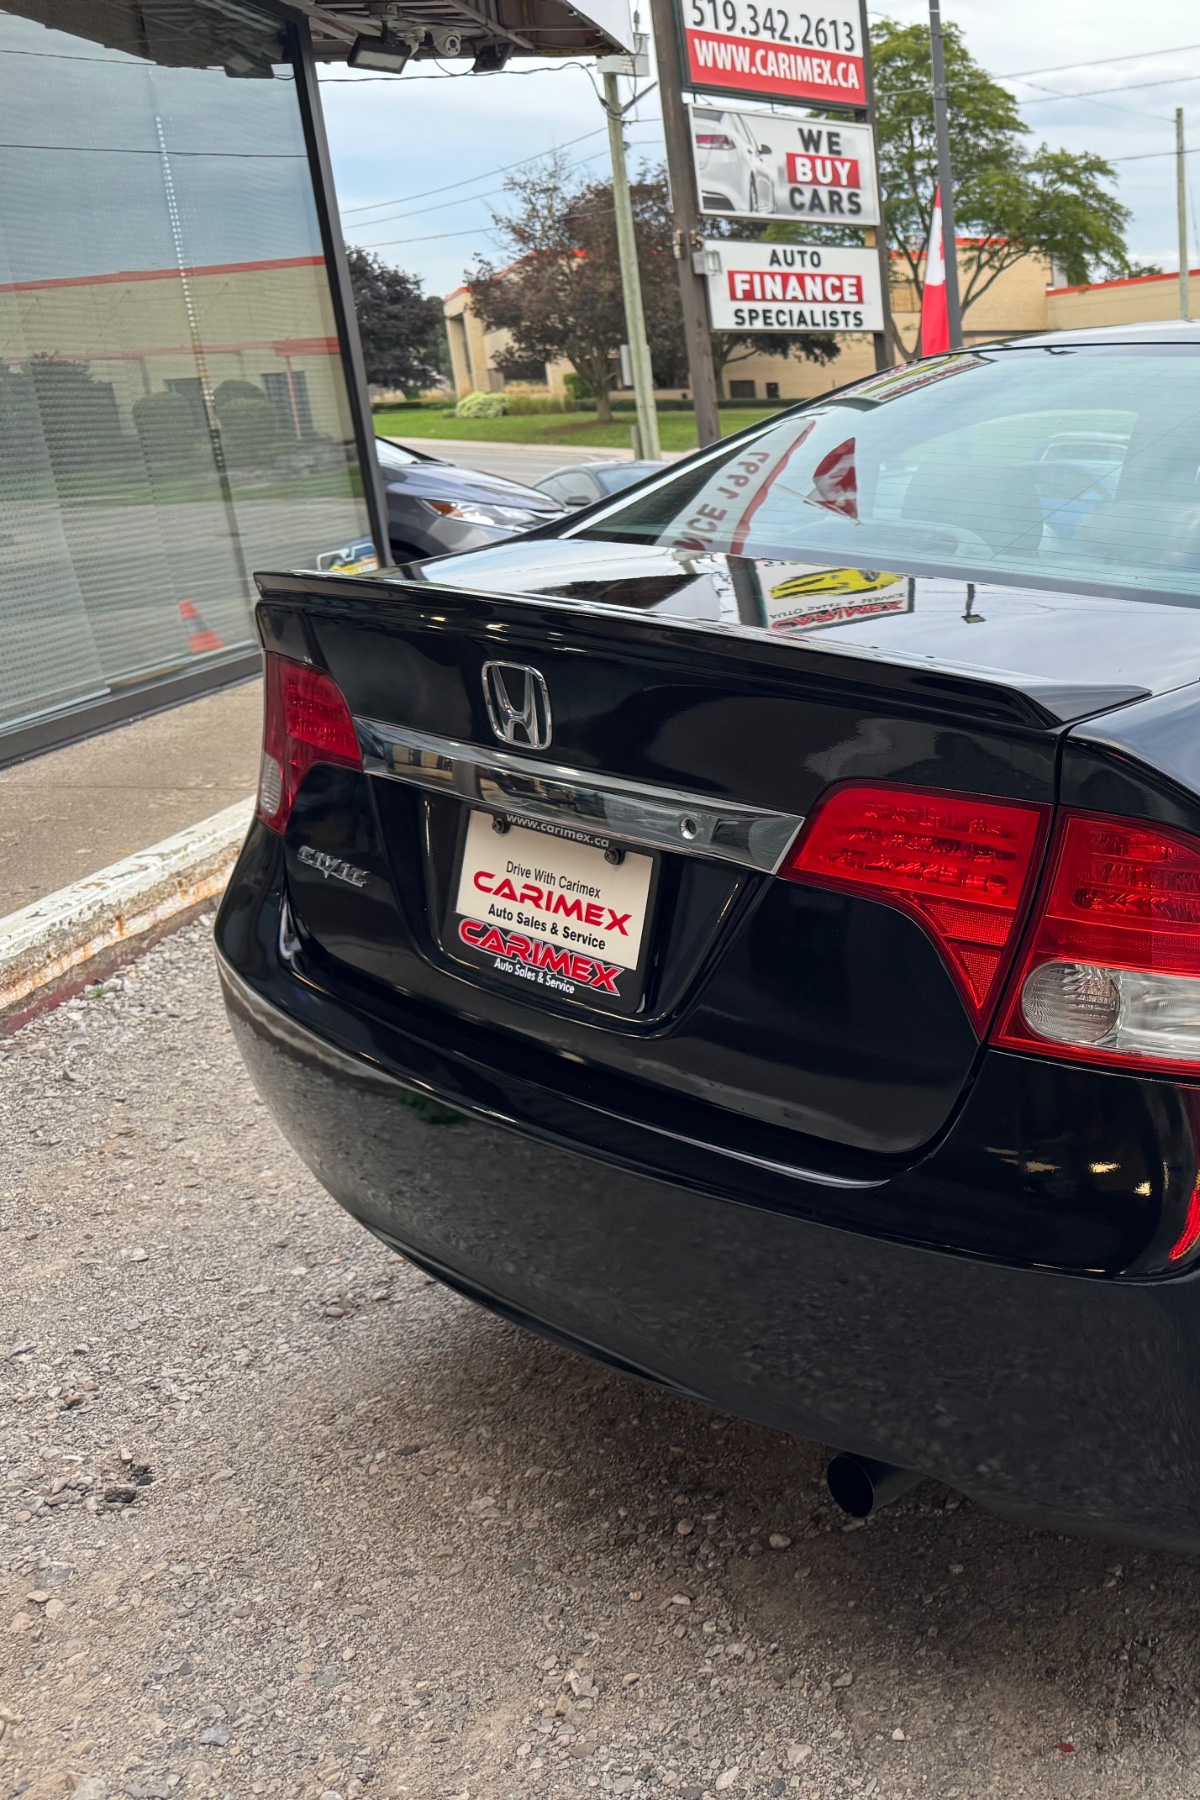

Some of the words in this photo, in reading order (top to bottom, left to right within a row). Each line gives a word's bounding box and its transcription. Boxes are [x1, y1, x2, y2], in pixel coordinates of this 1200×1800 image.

[692, 0, 855, 51] 519.342.2613
[693, 38, 860, 90] WWW.CARIMEX.CA
[799, 127, 842, 156] WE
[794, 156, 852, 186] BUY
[789, 187, 862, 215] CARS
[768, 249, 822, 268] AUTO
[733, 273, 859, 302] FINANCE
[734, 308, 864, 328] SPECIALISTS
[506, 813, 610, 848] www.carimex.ca
[506, 861, 531, 879] Drive
[534, 867, 556, 887] With
[559, 876, 602, 899] Carimex
[473, 871, 633, 936] CARIMEX
[488, 903, 514, 922] Auto
[516, 912, 547, 932] Sales
[550, 923, 559, 936] &
[562, 925, 606, 950] Service
[460, 919, 624, 995] CARIMEX
[493, 957, 513, 974] Auto
[514, 963, 536, 981] Sales
[537, 971, 544, 984] &
[545, 975, 575, 994] Service
